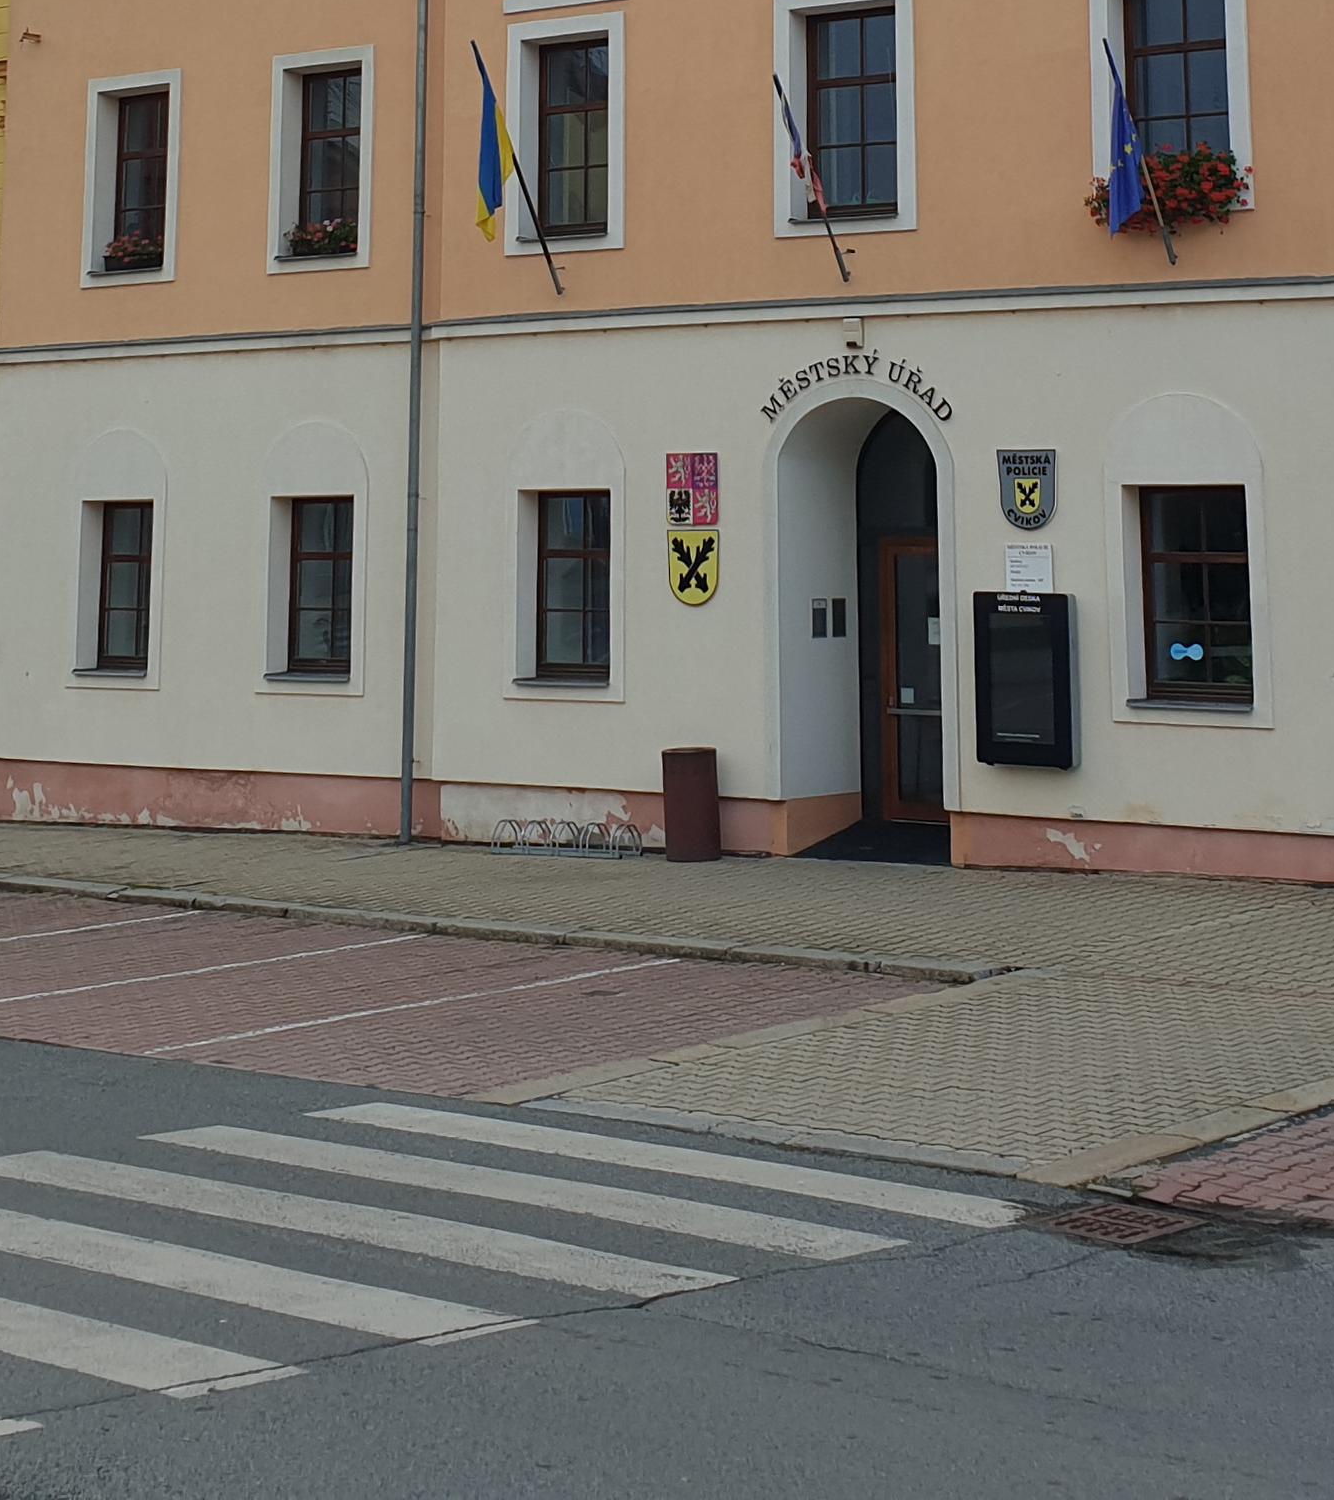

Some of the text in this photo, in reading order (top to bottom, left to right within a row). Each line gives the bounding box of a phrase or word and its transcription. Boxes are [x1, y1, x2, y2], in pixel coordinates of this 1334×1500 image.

[760, 349, 954, 422] MĚSTSKÝ ÚŘAD
[1002, 453, 1051, 465] MĚSTSKÁ
[1006, 466, 1048, 476] POLICIE
[1007, 508, 1047, 526] CVIKOV
